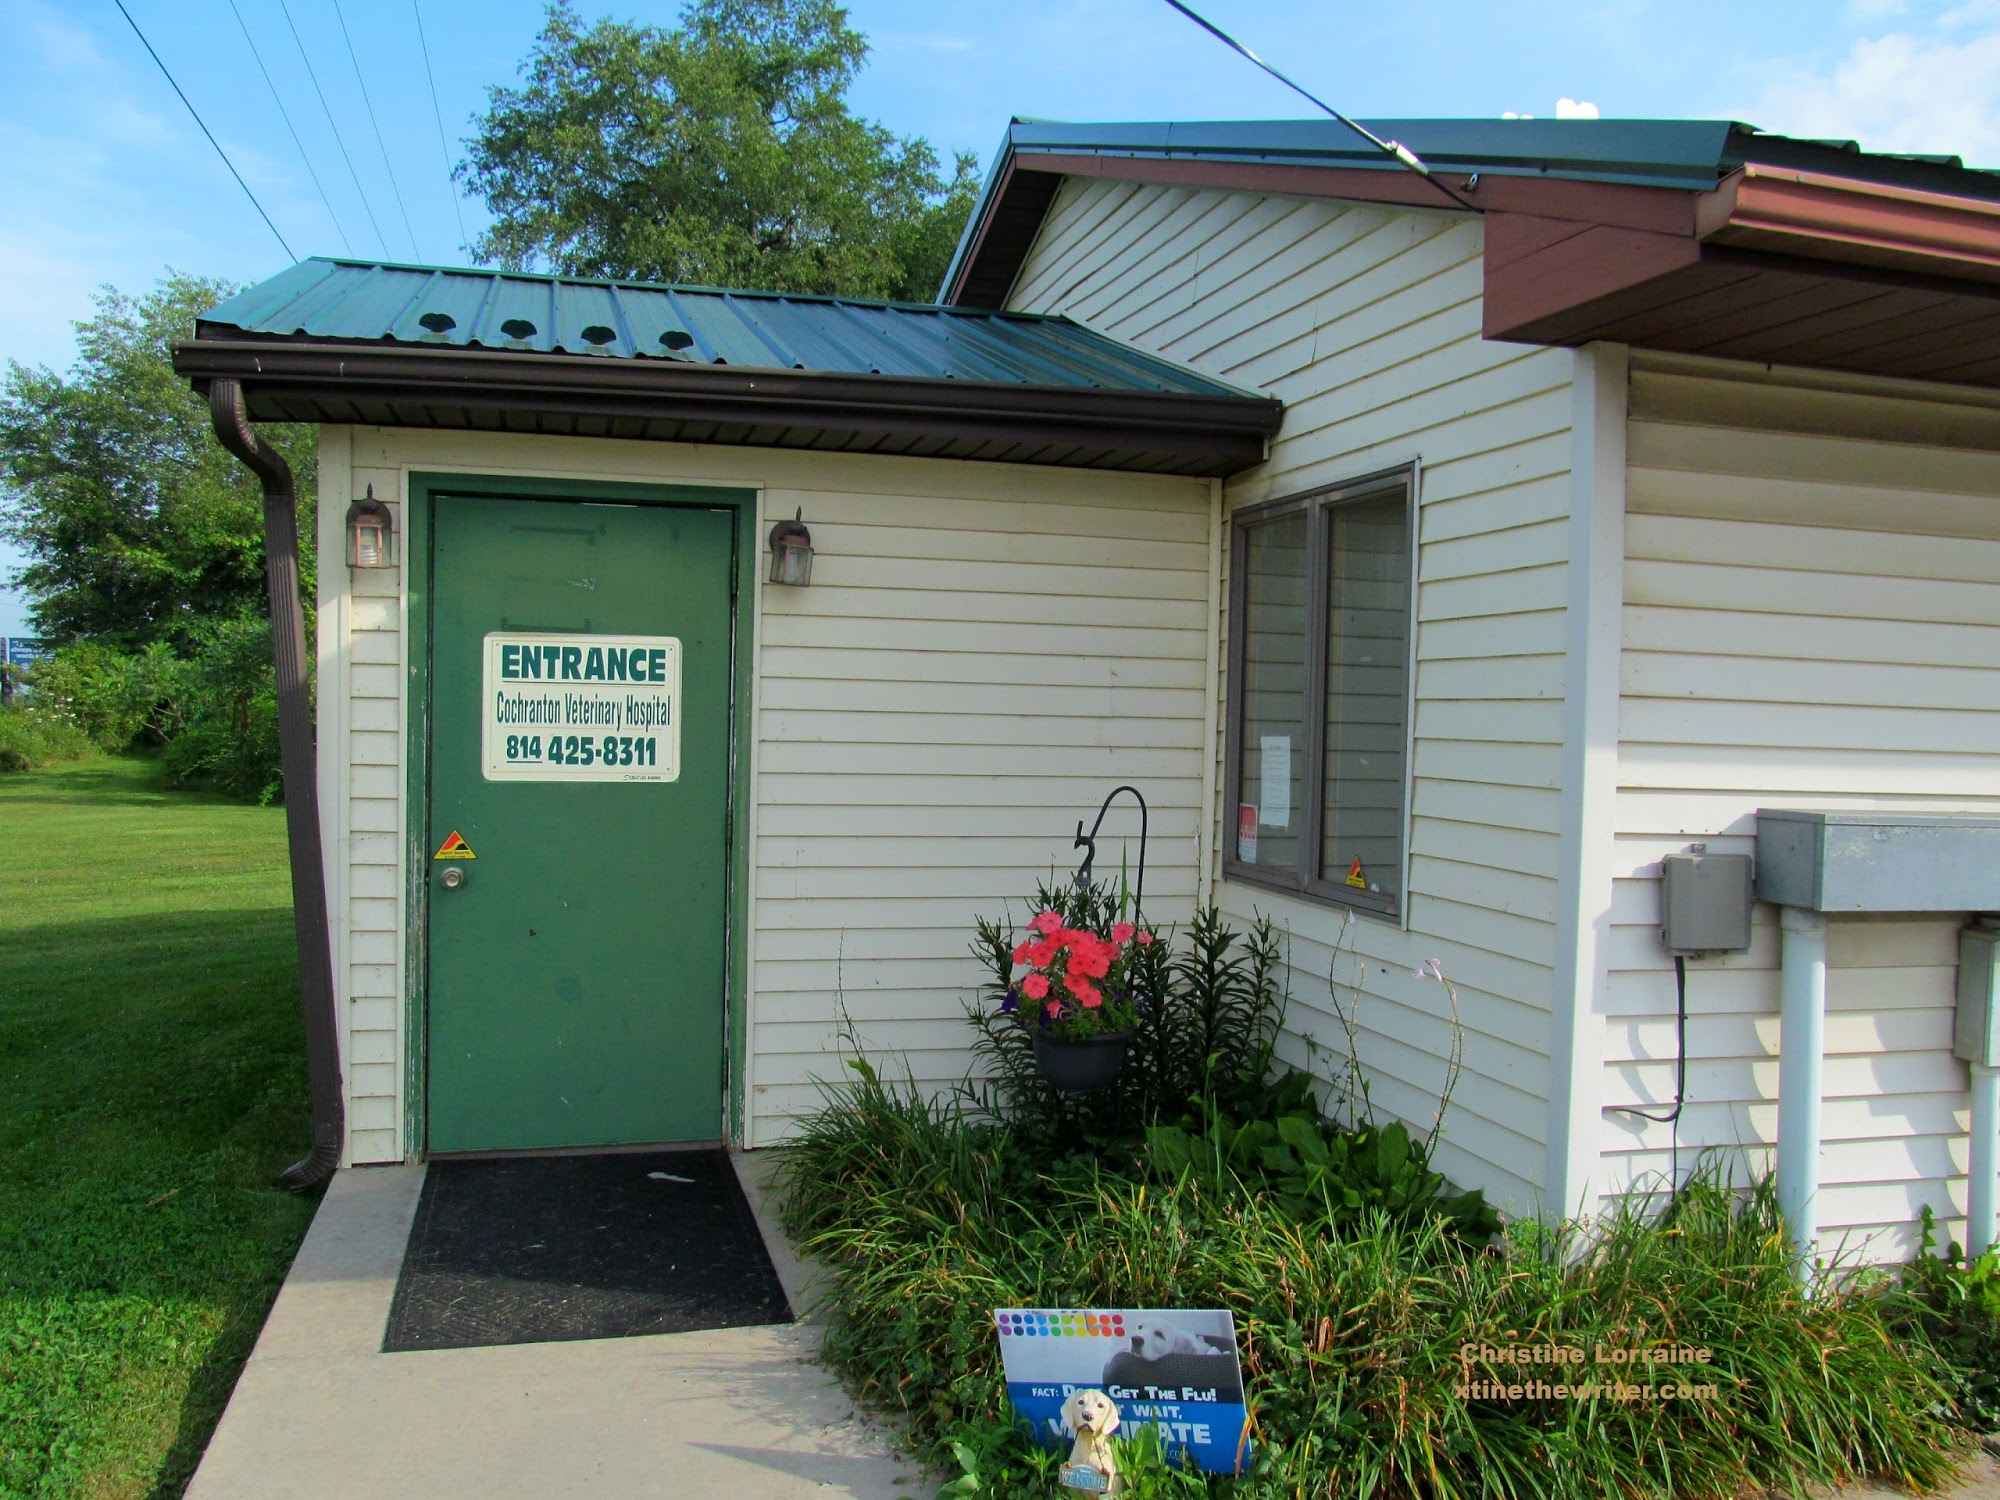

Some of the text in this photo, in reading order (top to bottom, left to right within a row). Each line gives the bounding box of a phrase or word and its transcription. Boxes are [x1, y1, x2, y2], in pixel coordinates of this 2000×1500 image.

[501, 645, 666, 682] ENTRANCE
[496, 691, 671, 732] Cochranton Veterinary Hospital
[506, 735, 657, 766] 814 425-8311
[1032, 1388, 1059, 1397] FACT:
[1132, 1404, 1183, 1420] WAIT,
[1061, 1470, 1107, 1489] WELCOME
